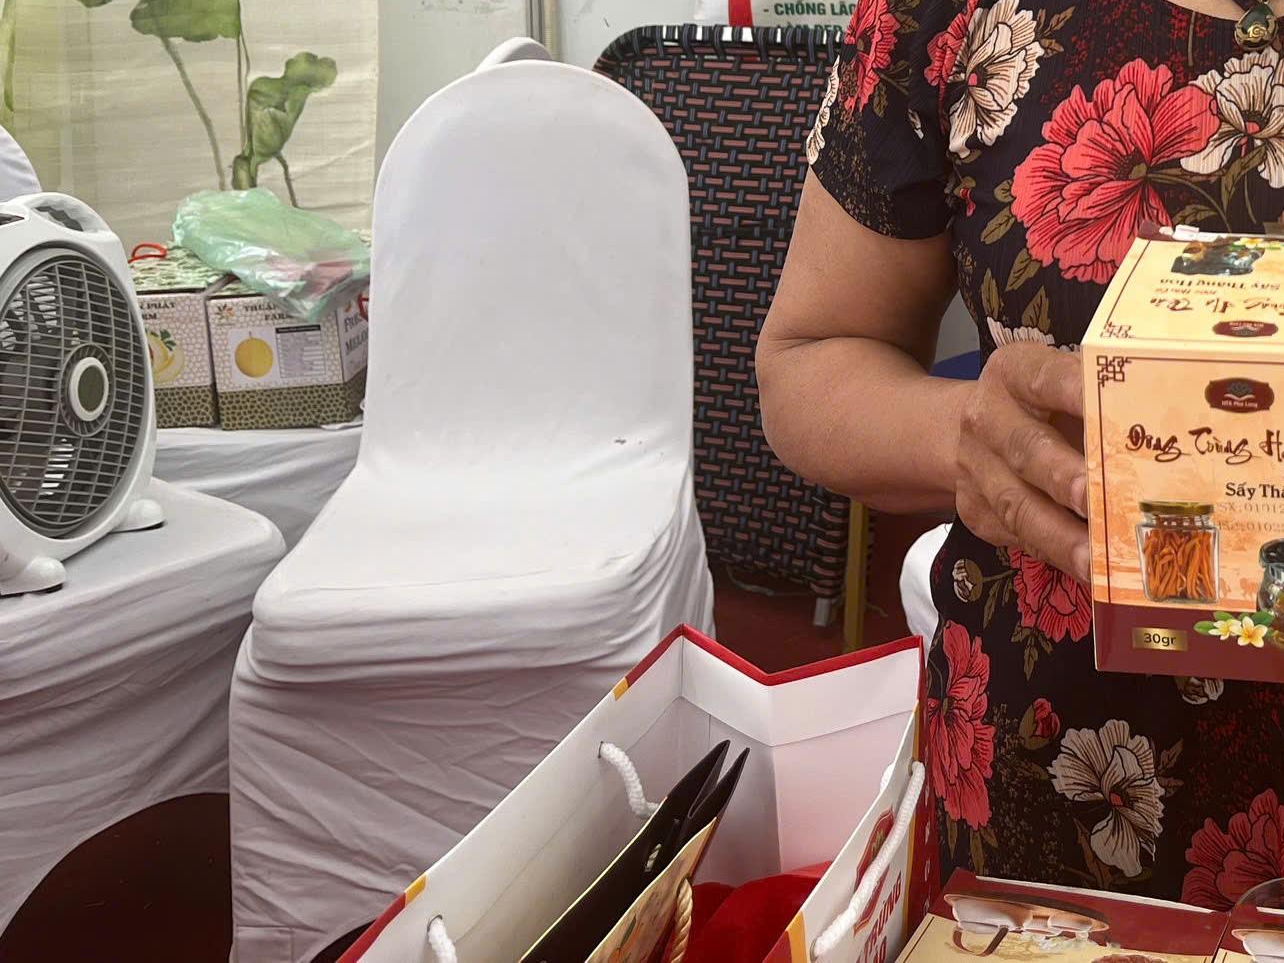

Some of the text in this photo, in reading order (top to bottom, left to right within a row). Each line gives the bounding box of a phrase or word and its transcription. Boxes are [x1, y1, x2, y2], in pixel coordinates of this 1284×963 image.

[774, 1, 826, 16] CHỐNG
[1226, 483, 1256, 499] Sấy
[1143, 633, 1176, 646] 30gr
